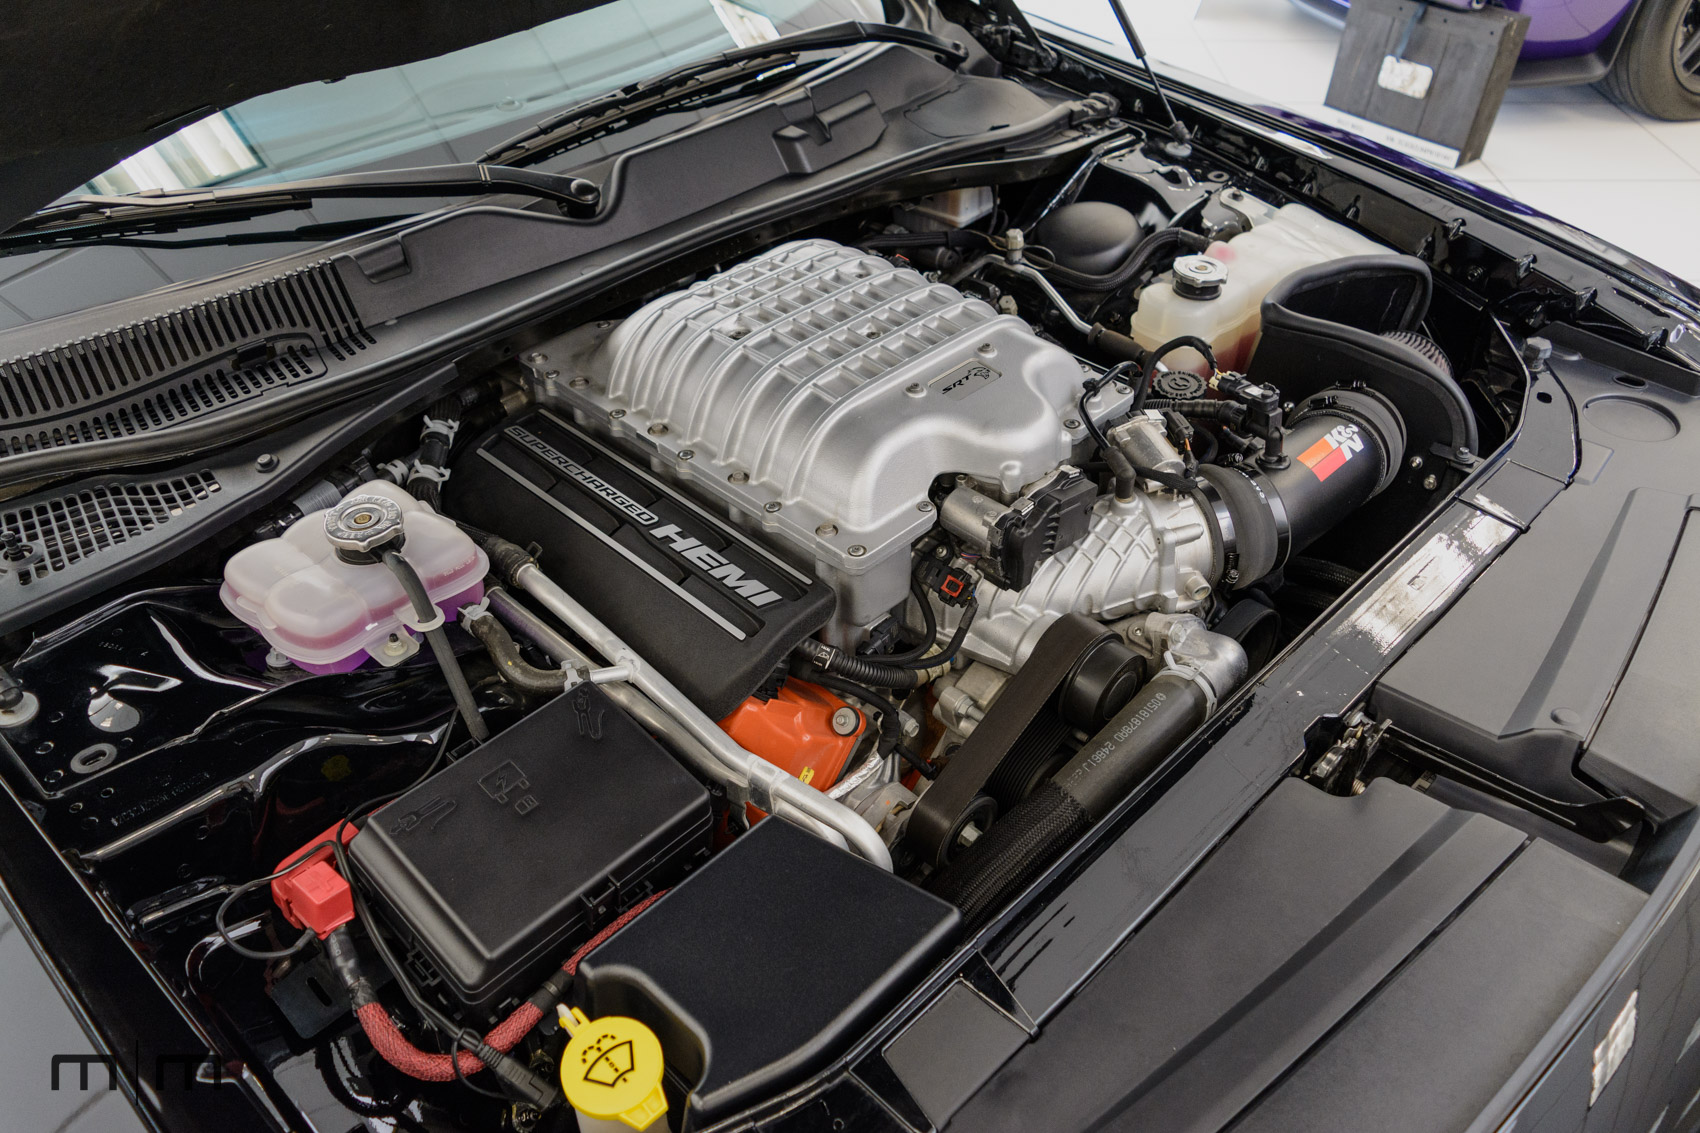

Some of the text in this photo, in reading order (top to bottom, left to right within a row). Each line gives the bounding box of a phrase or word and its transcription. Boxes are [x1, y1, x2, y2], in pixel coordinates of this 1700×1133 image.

[942, 373, 972, 395] SRT
[1323, 424, 1364, 462] K&N
[507, 425, 656, 525] SUPERCHARGED
[649, 523, 783, 608] HEMI
